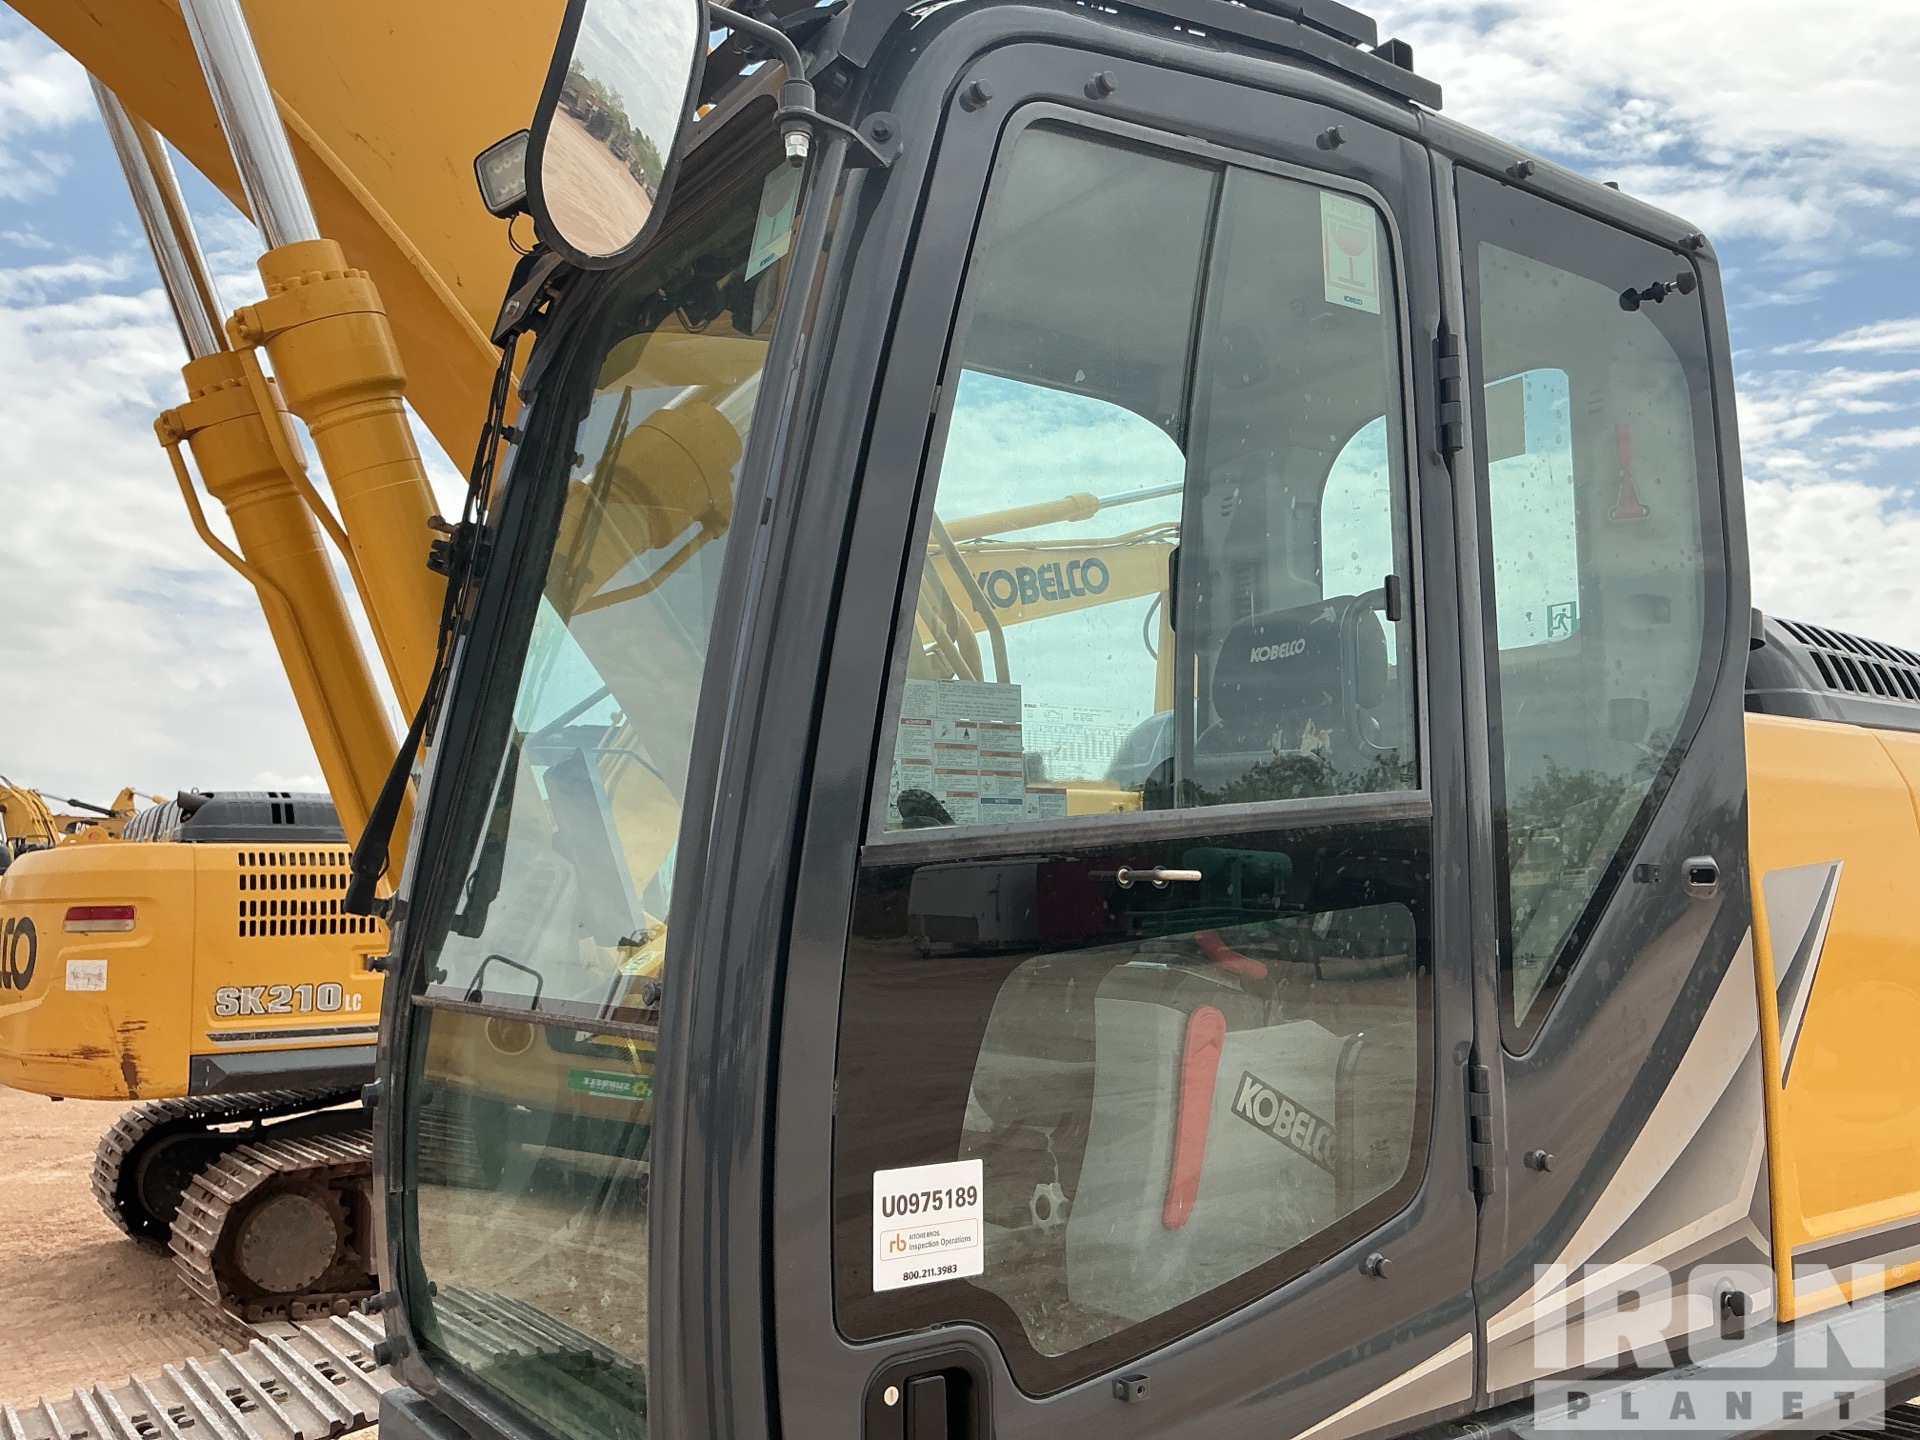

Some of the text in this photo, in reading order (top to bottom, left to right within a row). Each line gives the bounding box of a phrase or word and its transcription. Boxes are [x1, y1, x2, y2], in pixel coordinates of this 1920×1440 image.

[1250, 638, 1306, 663] KOBELCO
[0, 916, 37, 991] CO
[215, 981, 362, 1017] SK210 LC
[882, 1185, 978, 1218] U0975189
[889, 1233, 907, 1254] rb
[909, 1235, 972, 1251] Inspection Operations
[902, 1264, 958, 1281] 800.211.3983
